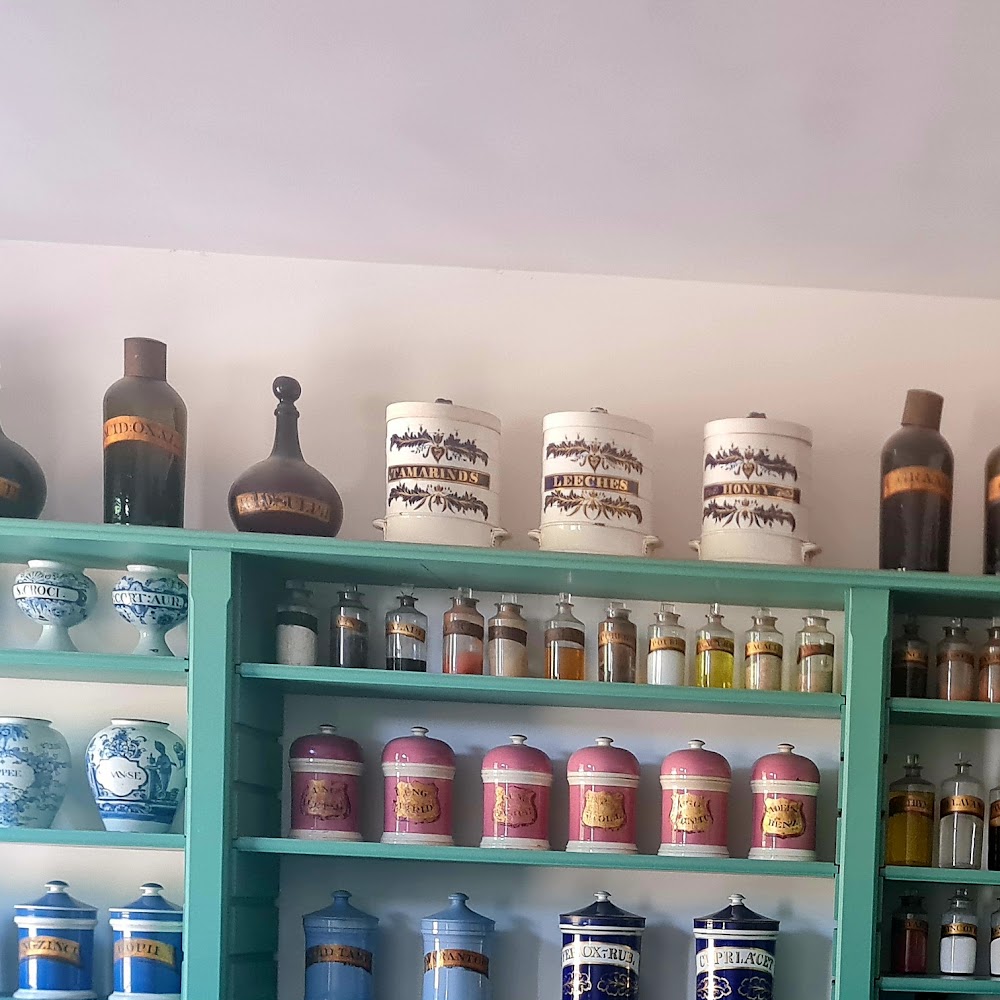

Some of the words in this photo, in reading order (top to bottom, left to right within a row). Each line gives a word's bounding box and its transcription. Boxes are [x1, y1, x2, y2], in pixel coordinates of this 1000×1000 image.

[392, 465, 479, 484] TAMARINDS
[552, 475, 628, 492] LEECHES
[722, 483, 770, 495] HONEY
